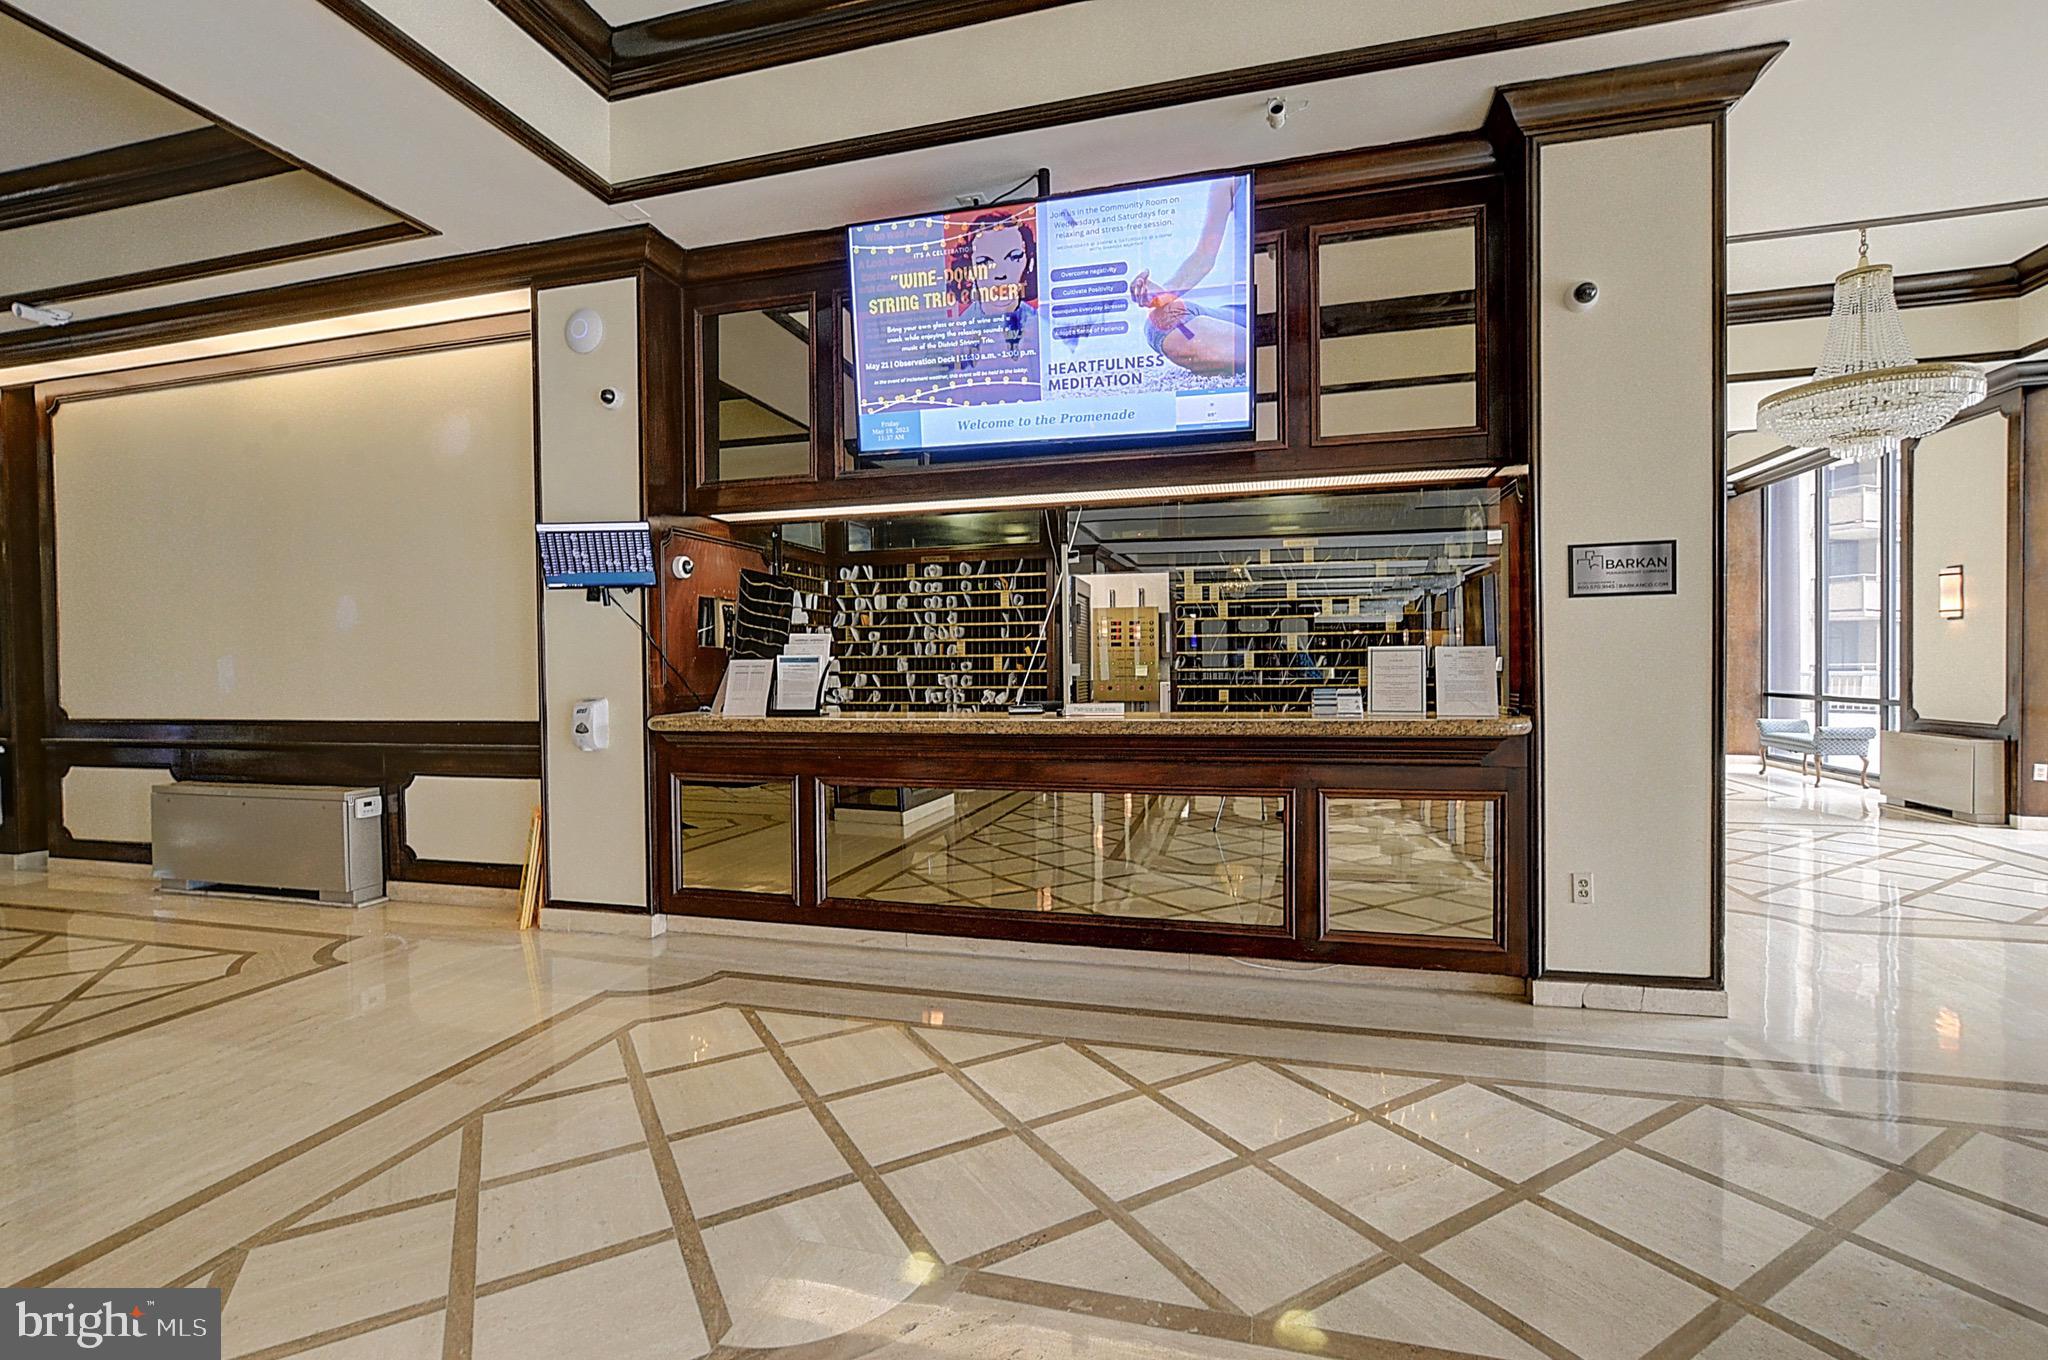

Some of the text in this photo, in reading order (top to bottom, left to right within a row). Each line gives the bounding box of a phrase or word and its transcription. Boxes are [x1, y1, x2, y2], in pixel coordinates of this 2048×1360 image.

[1049, 210, 1066, 219] Join
[1066, 209, 1076, 217] us
[1077, 208, 1085, 216] in
[1085, 205, 1099, 214] the
[1100, 200, 1144, 213] Community
[1145, 198, 1168, 207] Room
[1101, 214, 1116, 223] and
[1117, 210, 1156, 221] Saturdays
[1157, 208, 1170, 216] for
[1055, 220, 1175, 239] relaxing and stress-free session.
[1060, 266, 1118, 278] Overcome negativity
[868, 281, 1028, 315] STRING TRIO CONCERT
[1062, 285, 1114, 296] Cultivate Positivity
[1079, 305, 1103, 313] Everyday
[886, 326, 903, 334] Bring
[903, 325, 917, 333] your
[932, 321, 947, 330] glass
[968, 317, 976, 325] of
[904, 333, 920, 341] while
[920, 331, 945, 341] enjoying
[946, 329, 956, 337] the
[957, 328, 982, 336] relaxing
[982, 324, 1004, 333] sounds
[919, 342, 926, 350] of
[937, 340, 958, 348] District
[865, 362, 880, 371] May
[880, 361, 889, 369] 21
[893, 357, 937, 368] Observation
[937, 354, 956, 363] Deck
[1020, 349, 1037, 358] p.m.
[1048, 354, 1164, 376] HEARTFULNESS
[1048, 373, 1143, 391] MEDITATION
[957, 409, 1136, 431] Welcome to the Promenade
[1605, 556, 1668, 570] BARKAN
